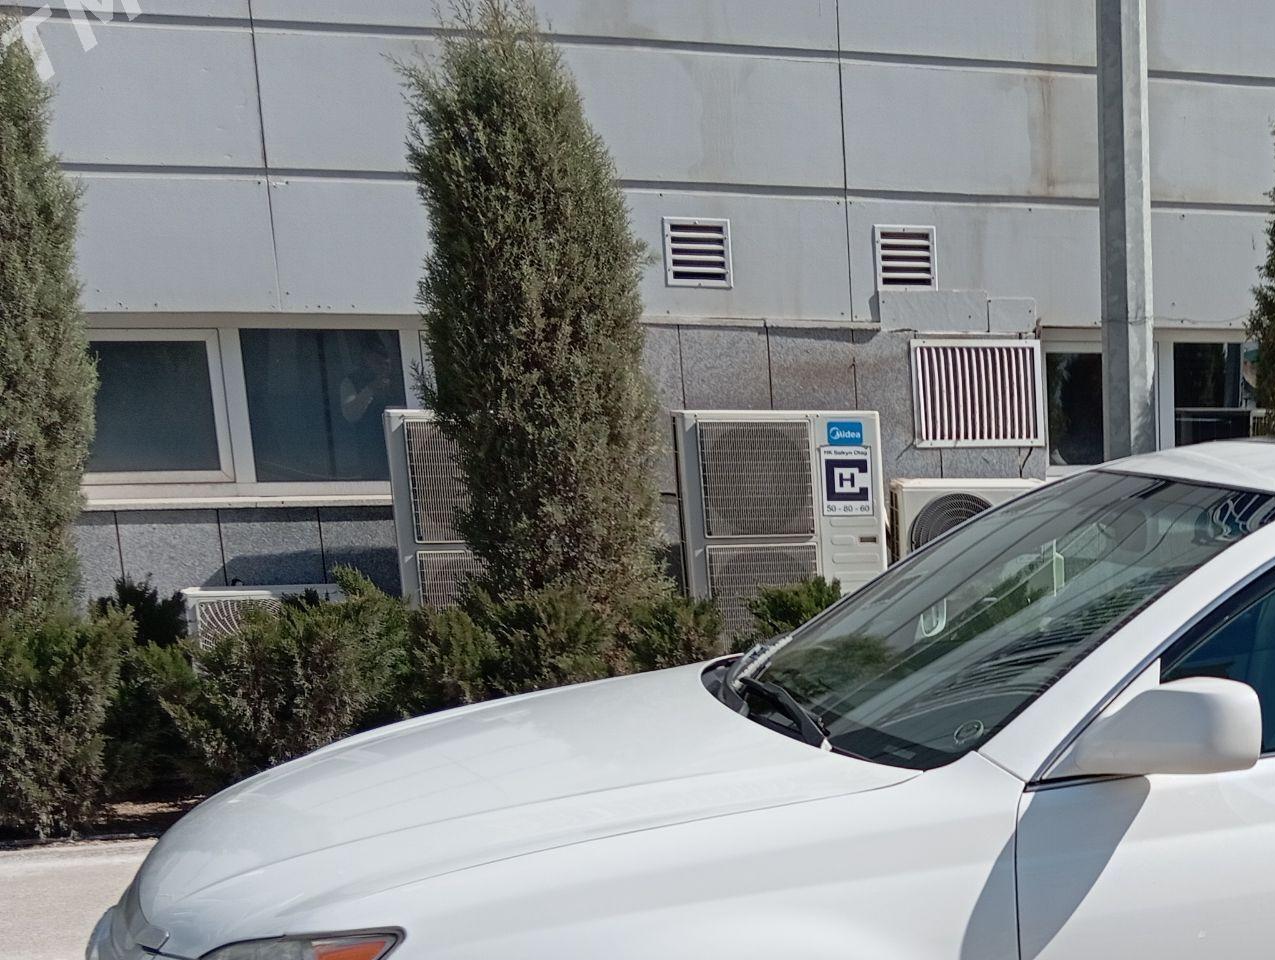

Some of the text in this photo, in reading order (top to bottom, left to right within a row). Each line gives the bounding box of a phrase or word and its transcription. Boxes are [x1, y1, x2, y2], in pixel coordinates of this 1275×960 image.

[829, 427, 861, 440] Midea
[826, 504, 836, 512] 50
[843, 504, 853, 512] 80
[860, 504, 870, 512] 60
